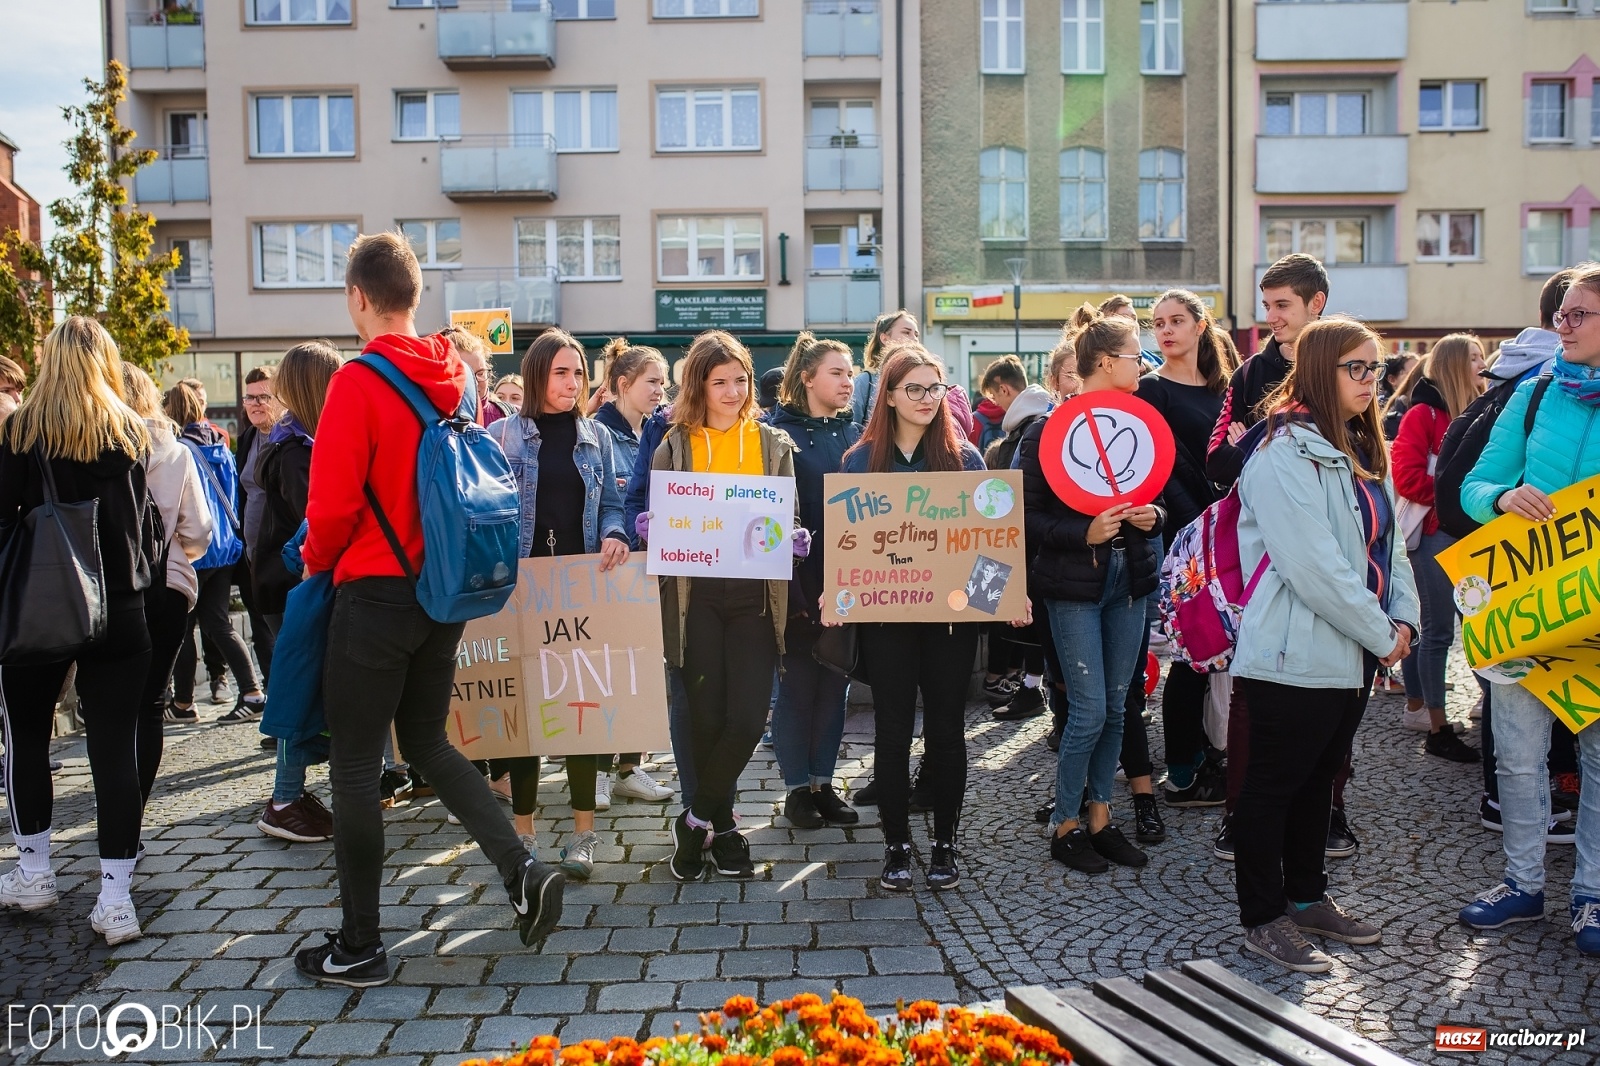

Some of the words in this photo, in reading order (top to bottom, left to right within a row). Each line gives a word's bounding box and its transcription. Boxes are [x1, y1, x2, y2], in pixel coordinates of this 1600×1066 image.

[667, 482, 715, 501] Kochaj
[725, 484, 784, 503] planetę,
[905, 485, 971, 521] Planet
[668, 516, 692, 530] tak
[701, 515, 724, 534] jak
[837, 529, 858, 551] is
[872, 521, 938, 555] getting
[946, 526, 1020, 555] HOTTER
[661, 547, 720, 567] kobietę!
[886, 552, 913, 566] Than
[837, 568, 933, 587] LEONARDO
[543, 616, 592, 645] JAK
[539, 644, 637, 702] DNI
[446, 701, 617, 746] LANETY
[112, 914, 128, 923] FILA
